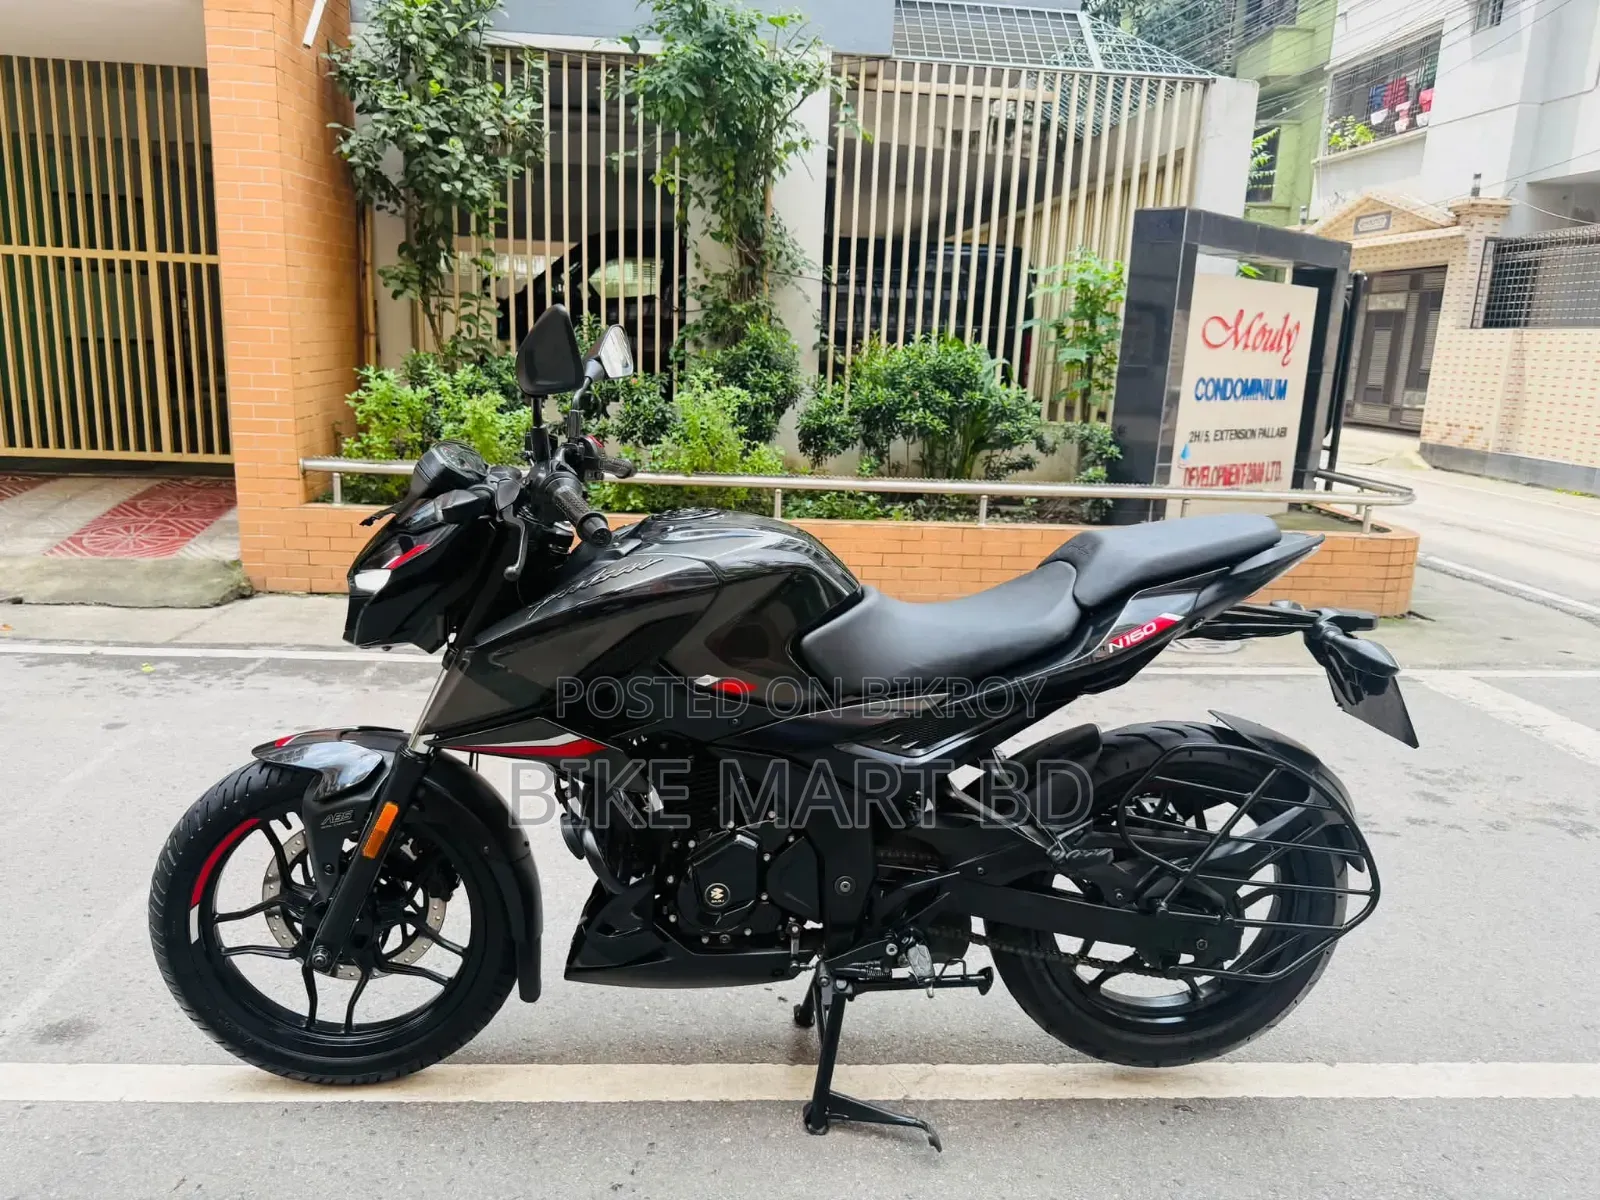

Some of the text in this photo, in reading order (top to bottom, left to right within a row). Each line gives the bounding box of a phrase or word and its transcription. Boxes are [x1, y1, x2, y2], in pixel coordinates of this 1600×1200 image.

[1202, 309, 1300, 367] Mouly
[1213, 428, 1257, 442] EXTENSION
[1108, 621, 1157, 654] N160
